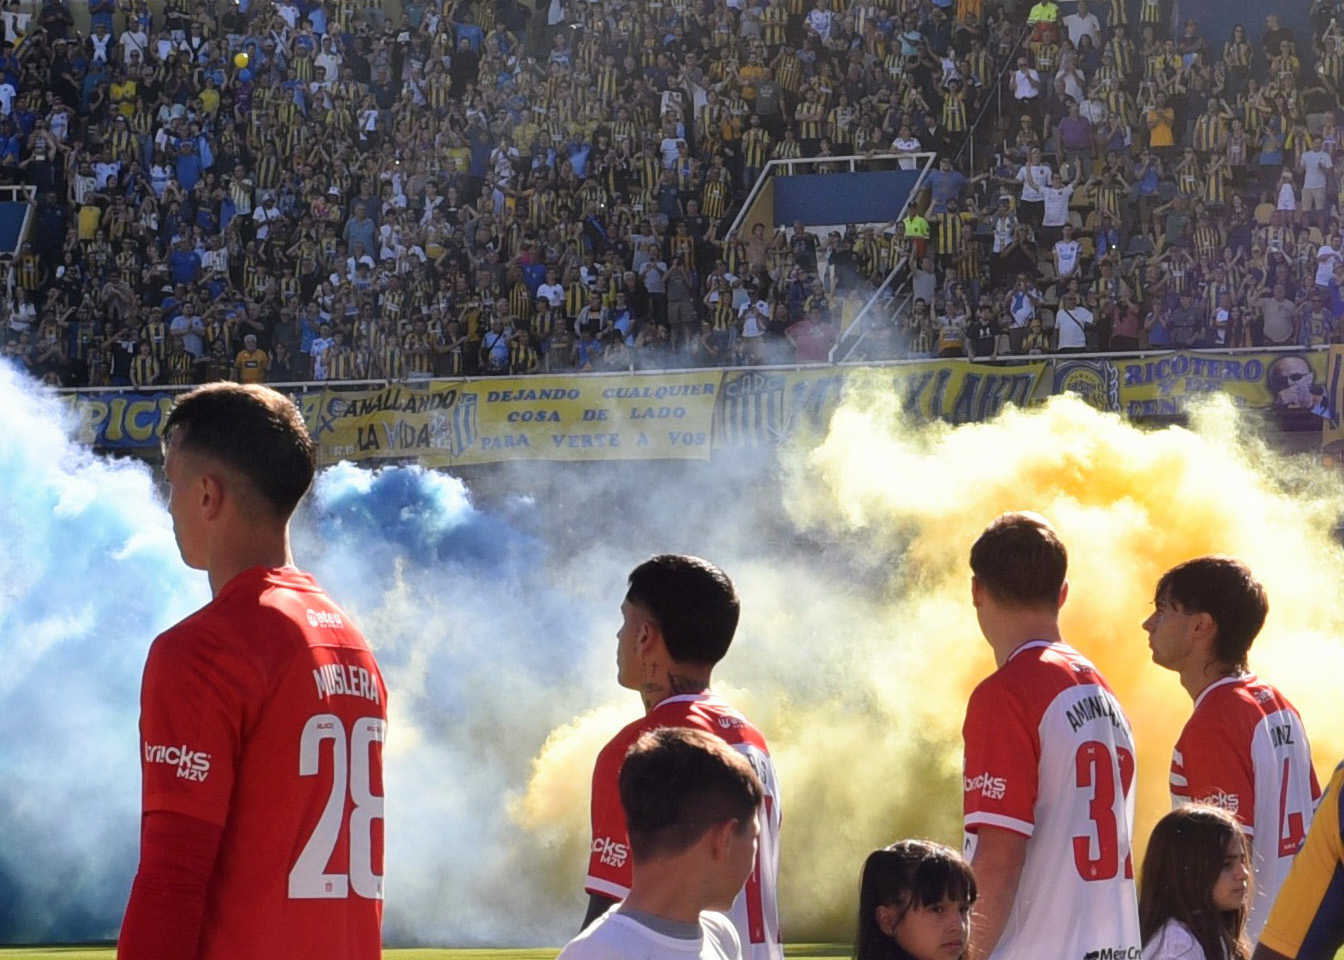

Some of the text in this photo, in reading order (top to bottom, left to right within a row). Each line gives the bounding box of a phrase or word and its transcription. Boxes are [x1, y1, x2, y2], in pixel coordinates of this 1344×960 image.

[1125, 355, 1264, 387] RICOTERO
[486, 383, 714, 403] DEJANDO CUALQUIER
[507, 407, 686, 422] COSA DE LADO
[358, 424, 379, 451] LA
[480, 431, 706, 450] PARA VERTE A VOS
[312, 665, 379, 705] MUSLERA
[176, 767, 208, 782] M2V
[288, 714, 385, 899] 28
